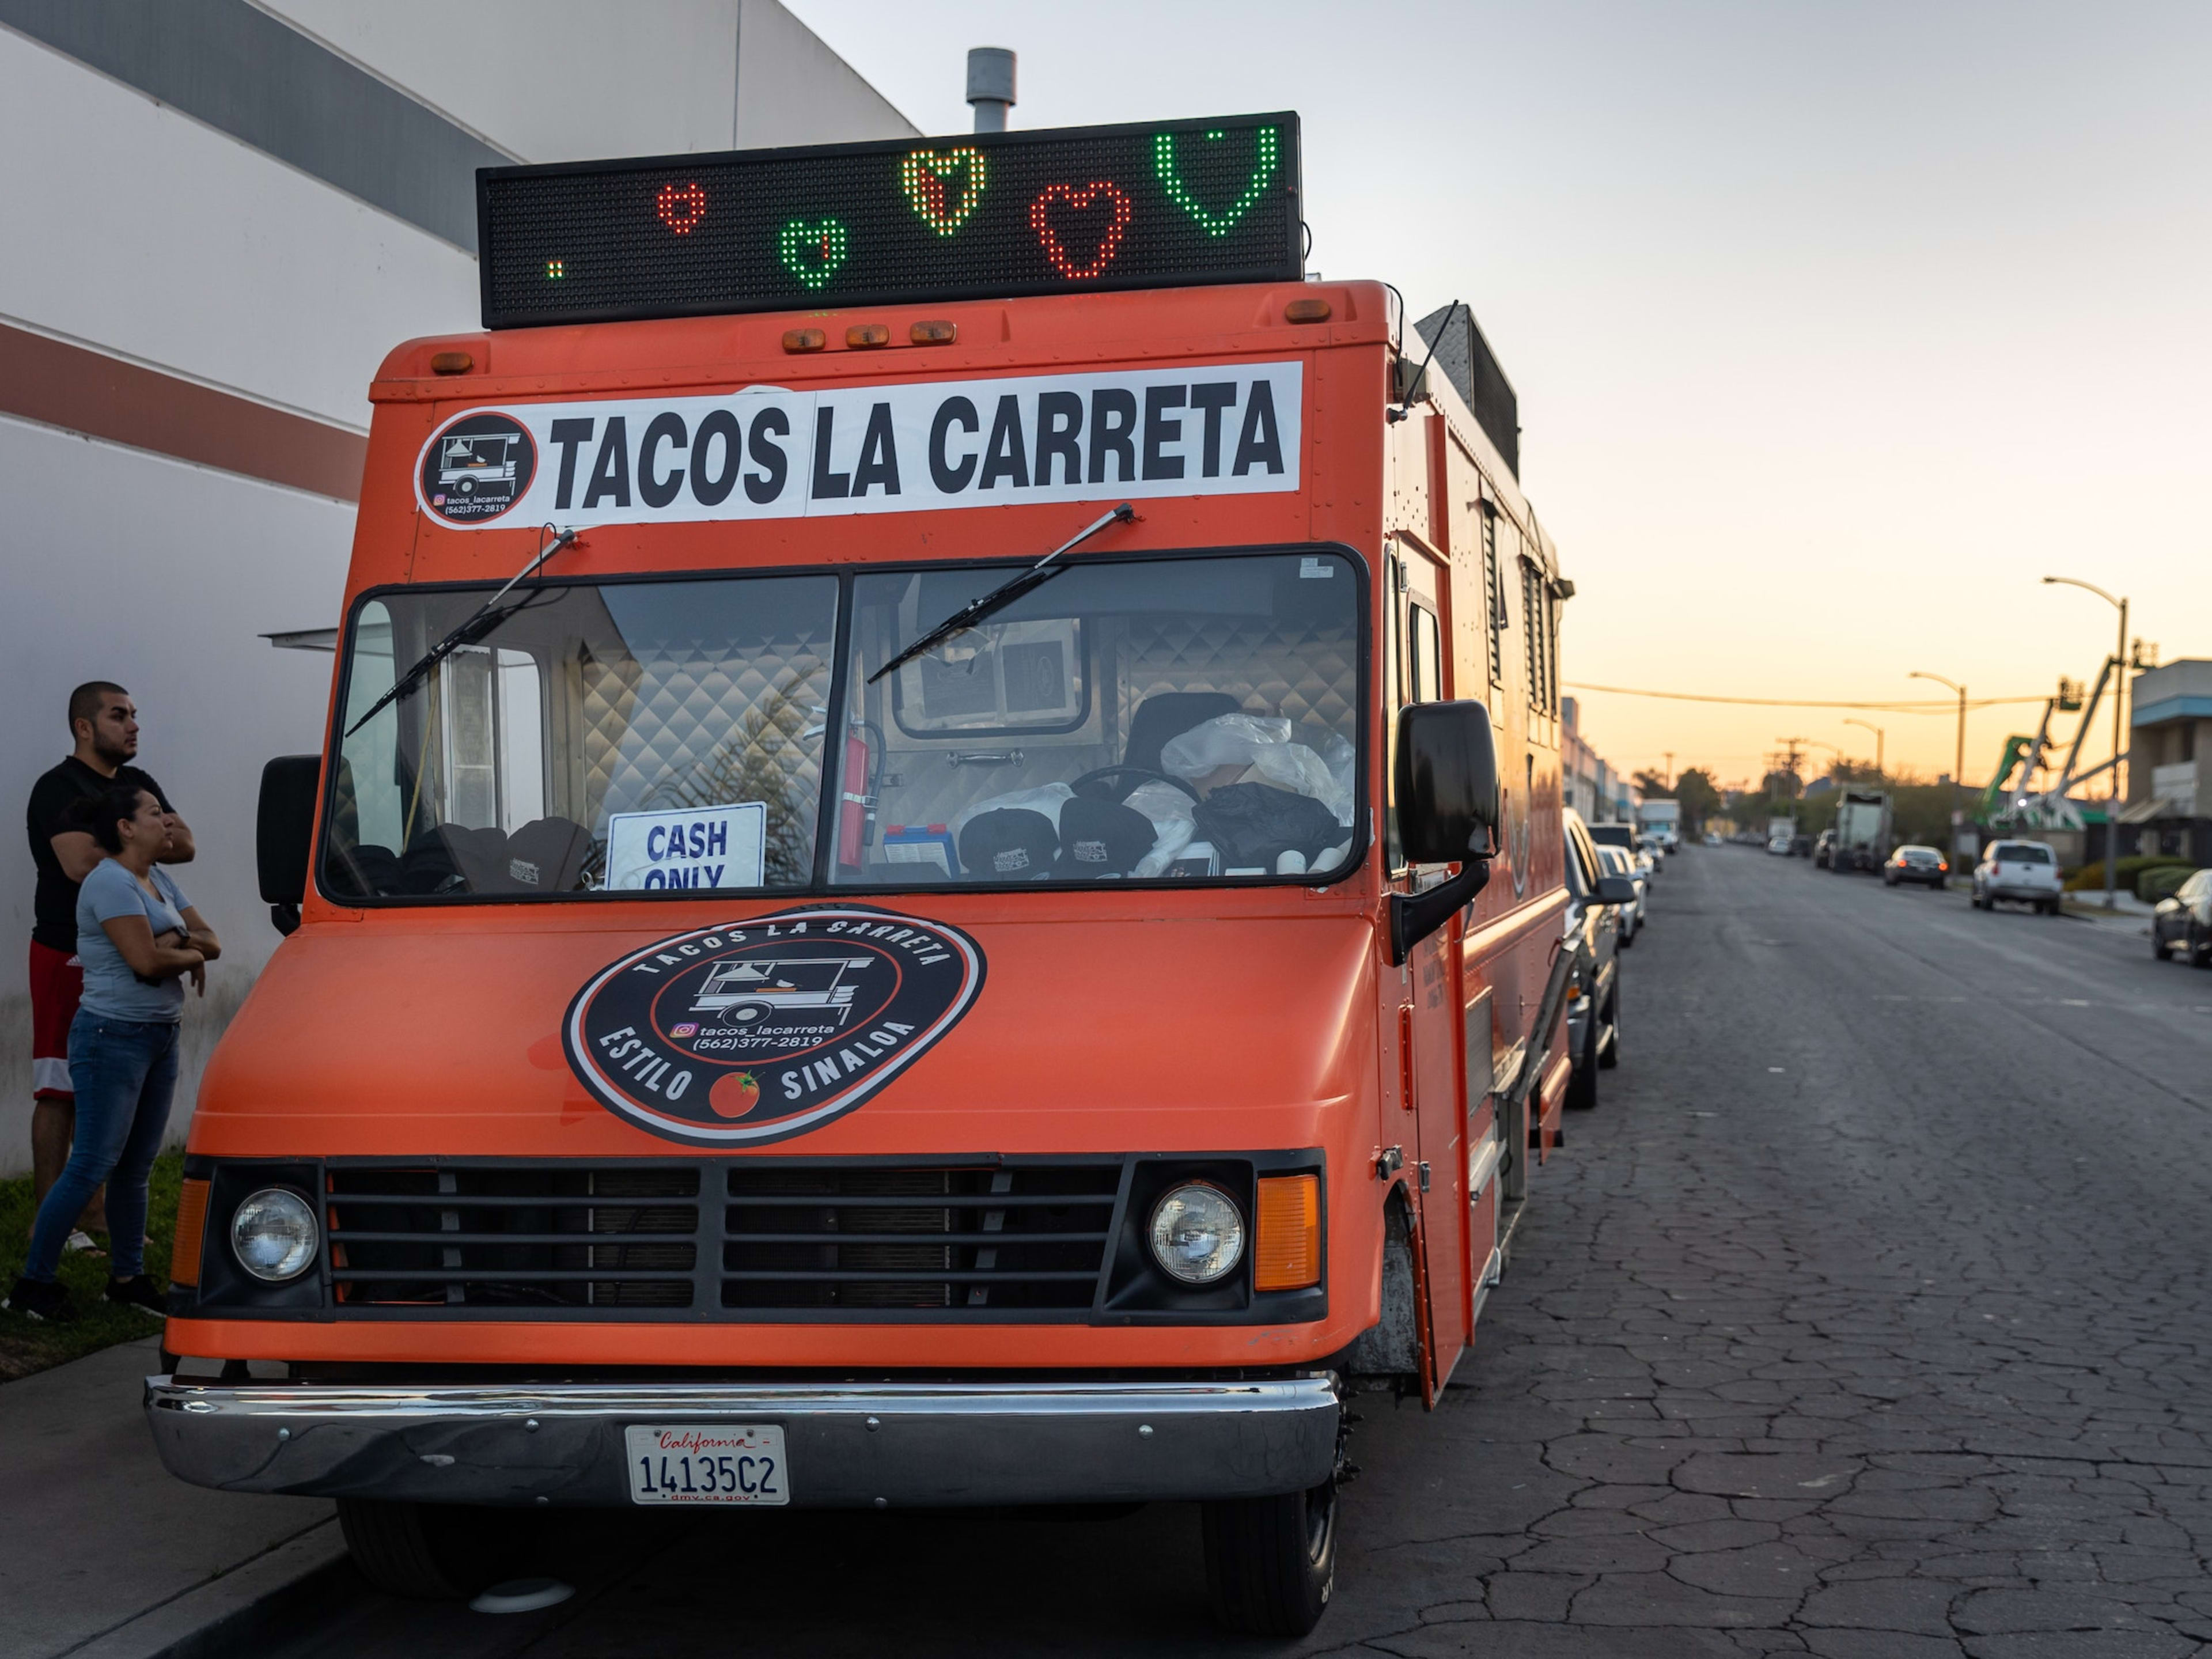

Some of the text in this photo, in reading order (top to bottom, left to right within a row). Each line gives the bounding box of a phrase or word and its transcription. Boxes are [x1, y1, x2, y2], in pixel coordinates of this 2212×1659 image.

[550, 380, 1285, 509] TACOS LA CARRETA
[445, 504, 506, 515] (562)377-2819
[446, 495, 510, 506] tacos_lacarreta
[647, 820, 728, 862] CASH
[633, 930, 747, 974] TACOS
[767, 922, 807, 936] LA
[692, 1037, 823, 1051] (562)377-2819
[700, 1025, 835, 1037] tacos_lacarreta
[599, 1020, 915, 1101] ESTILO SINALOA
[660, 1431, 756, 1455] California
[640, 1456, 778, 1493] 14135C2
